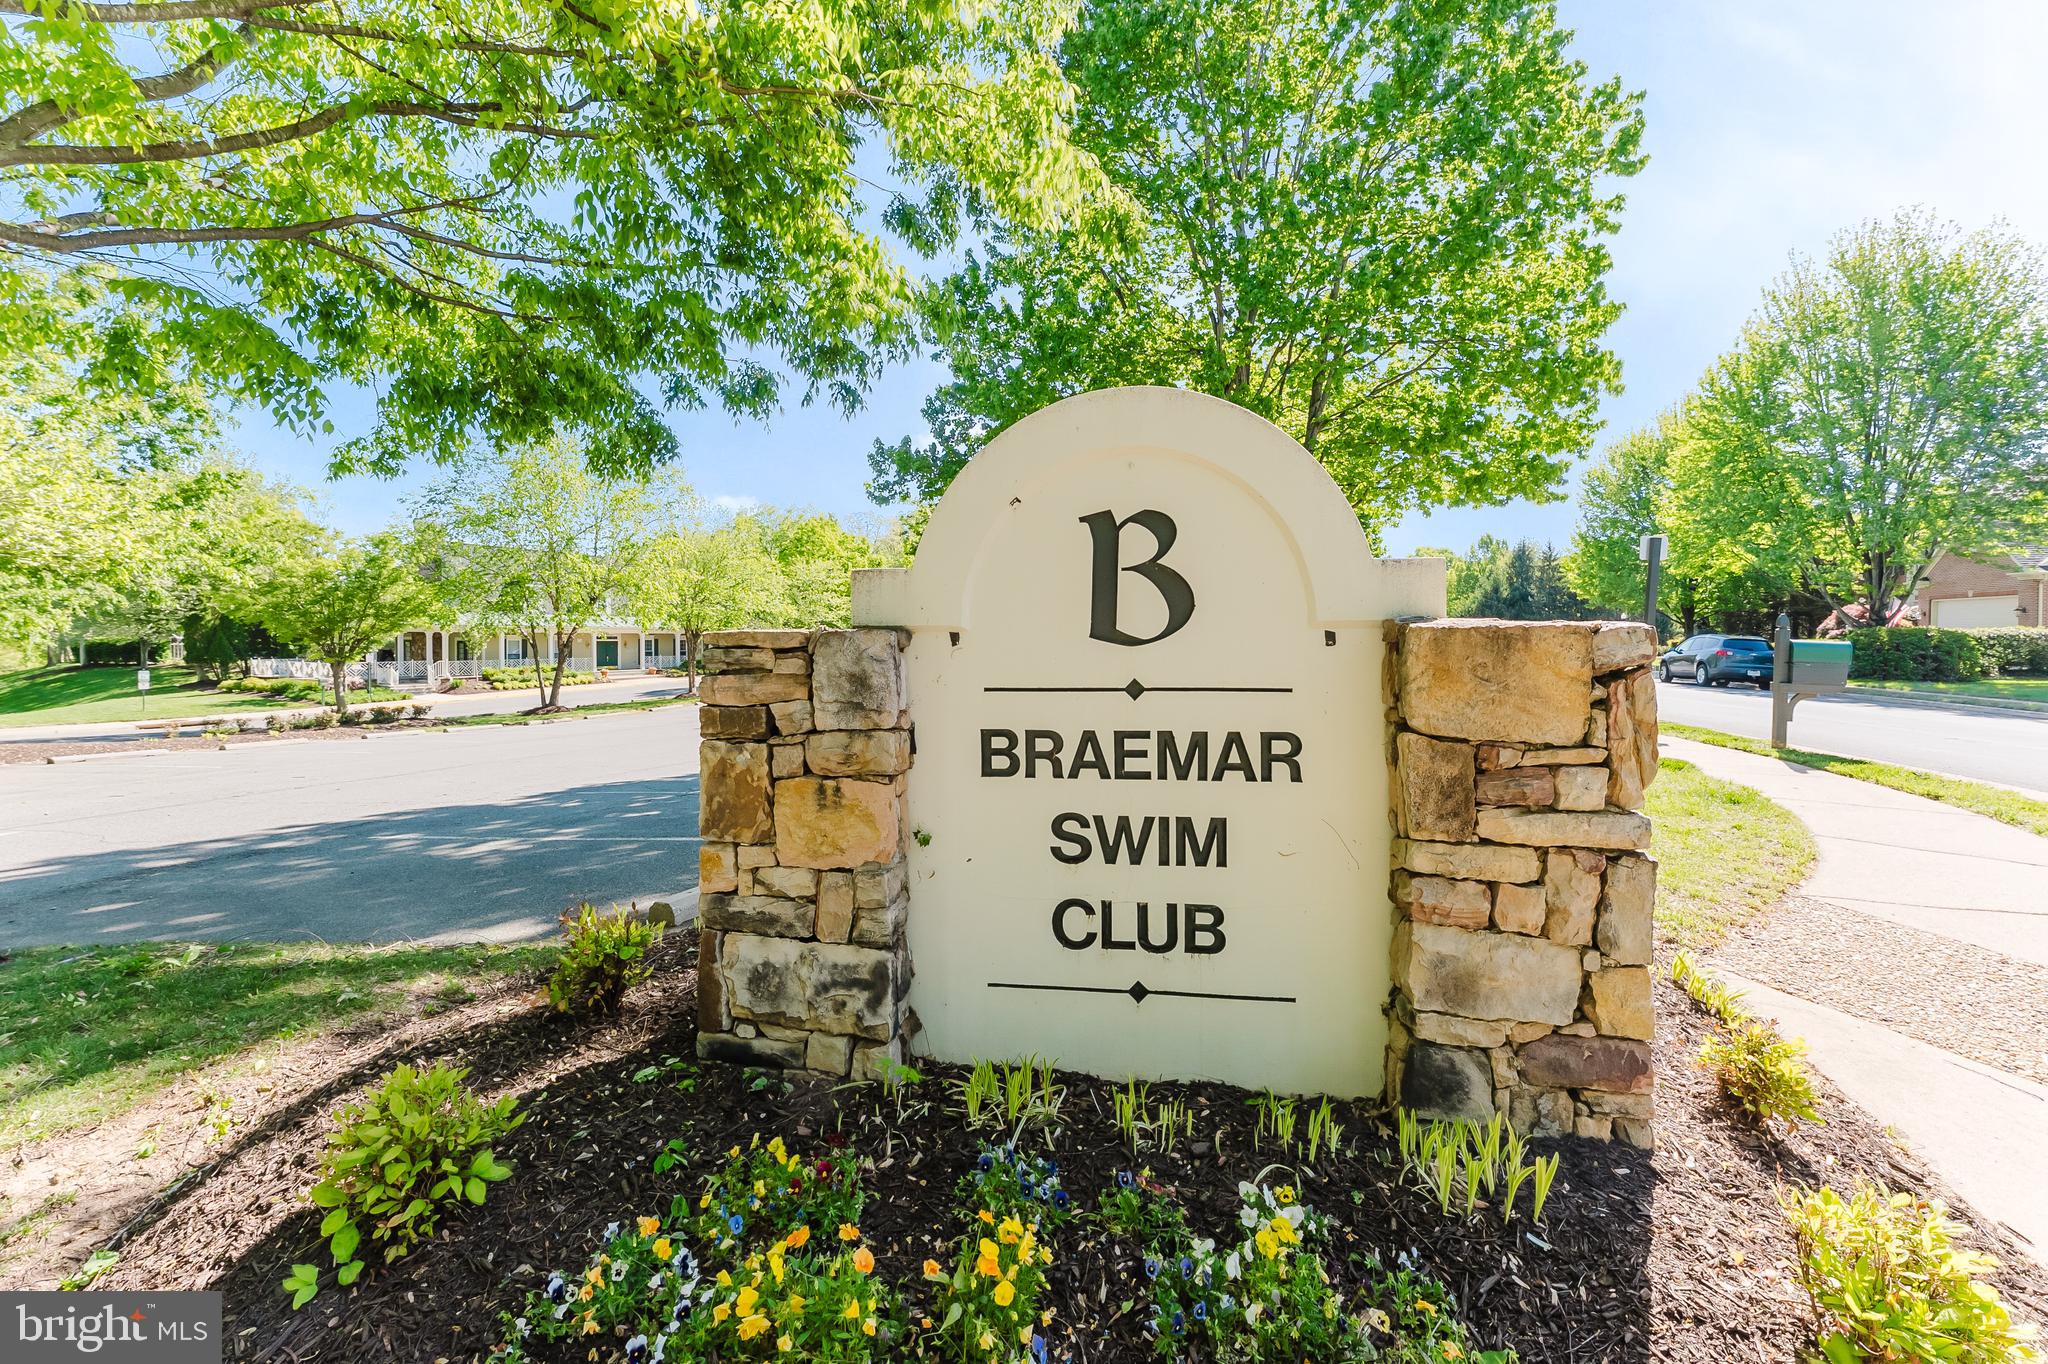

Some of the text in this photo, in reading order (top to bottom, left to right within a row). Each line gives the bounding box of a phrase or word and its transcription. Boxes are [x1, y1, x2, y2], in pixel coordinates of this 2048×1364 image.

[1079, 509, 1196, 647] B
[980, 728, 1303, 783] BRAEMAR
[1050, 812, 1228, 868] SWIM
[1051, 898, 1227, 955] CLUB
